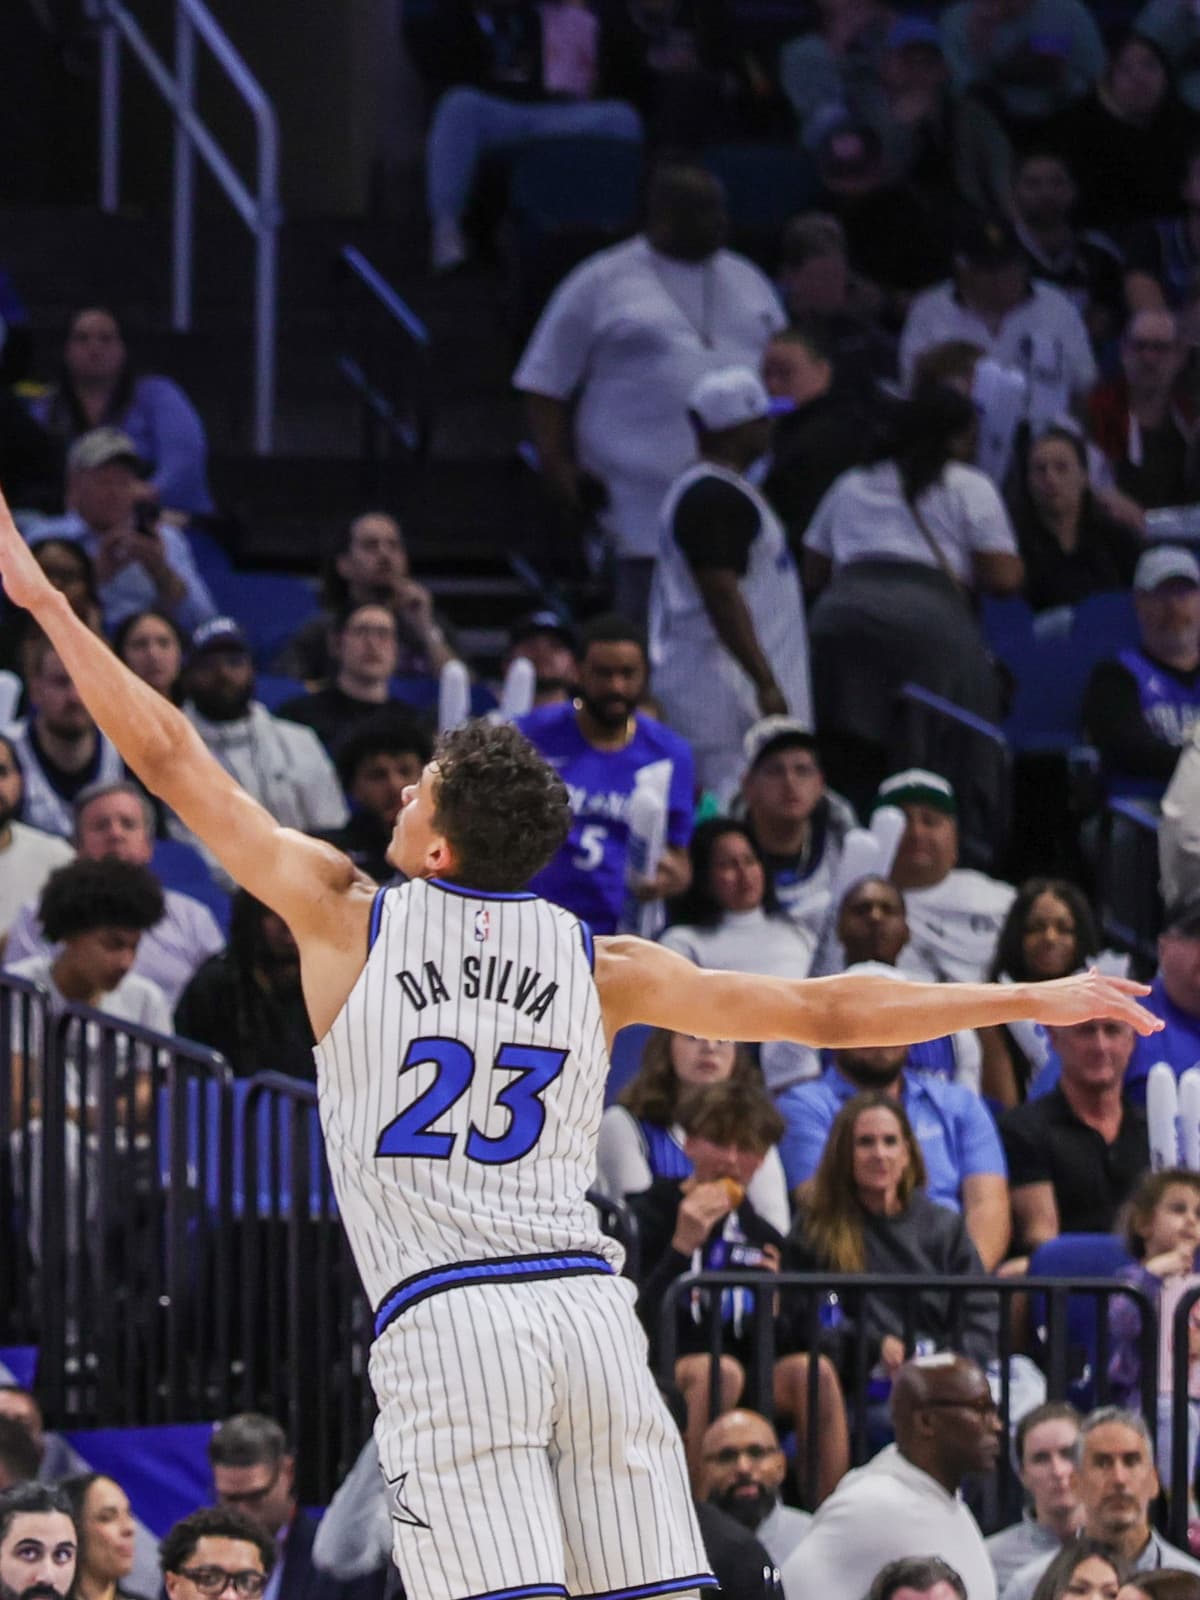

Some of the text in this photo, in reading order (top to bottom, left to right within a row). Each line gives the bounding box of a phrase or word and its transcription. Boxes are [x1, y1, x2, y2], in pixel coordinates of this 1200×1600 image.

[571, 824, 608, 872] 5
[396, 956, 560, 1024] DA SILVA
[374, 1036, 571, 1166] 23
